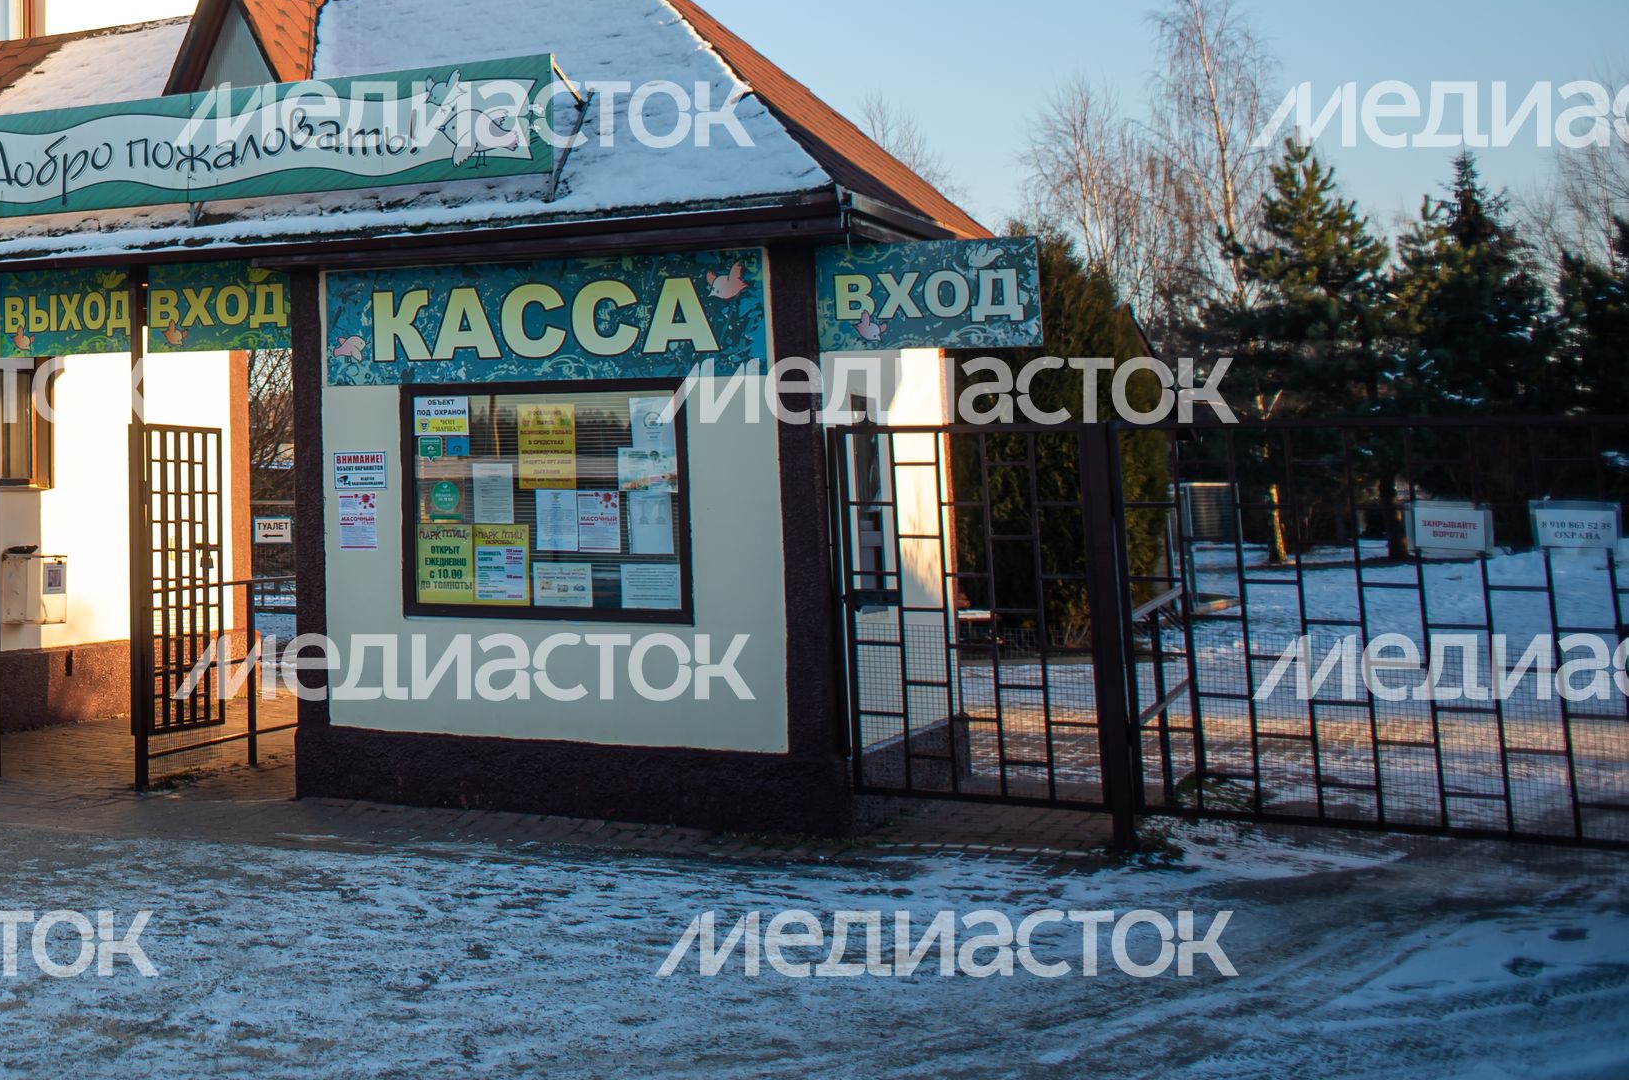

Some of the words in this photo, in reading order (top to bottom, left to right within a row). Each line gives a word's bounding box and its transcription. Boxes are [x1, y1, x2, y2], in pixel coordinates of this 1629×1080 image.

[128, 105, 421, 177] пожаловать!
[834, 268, 1025, 322] ВХОД
[149, 284, 287, 329] ВХОД
[3, 290, 131, 335] ВЫХОД
[372, 276, 719, 362] КАССА
[434, 408, 467, 416] ОХРАНОЙ
[336, 454, 383, 464] ВНИМАНИЕ!
[257, 522, 289, 530] ТУАЛЕТ
[1422, 519, 1477, 530] ЗАКРЫВАЙТЕ
[1587, 522, 1598, 530] 52
[419, 530, 442, 540] ПАРК
[1432, 530, 1468, 539] ВОРОТА!
[1554, 531, 1601, 540] ОХРАНА
[430, 545, 460, 554] ОТКРЫТ
[425, 557, 467, 567] ЕЖЕДНЕВНО
[437, 569, 463, 579] 10.00
[420, 580, 431, 590] ДО
